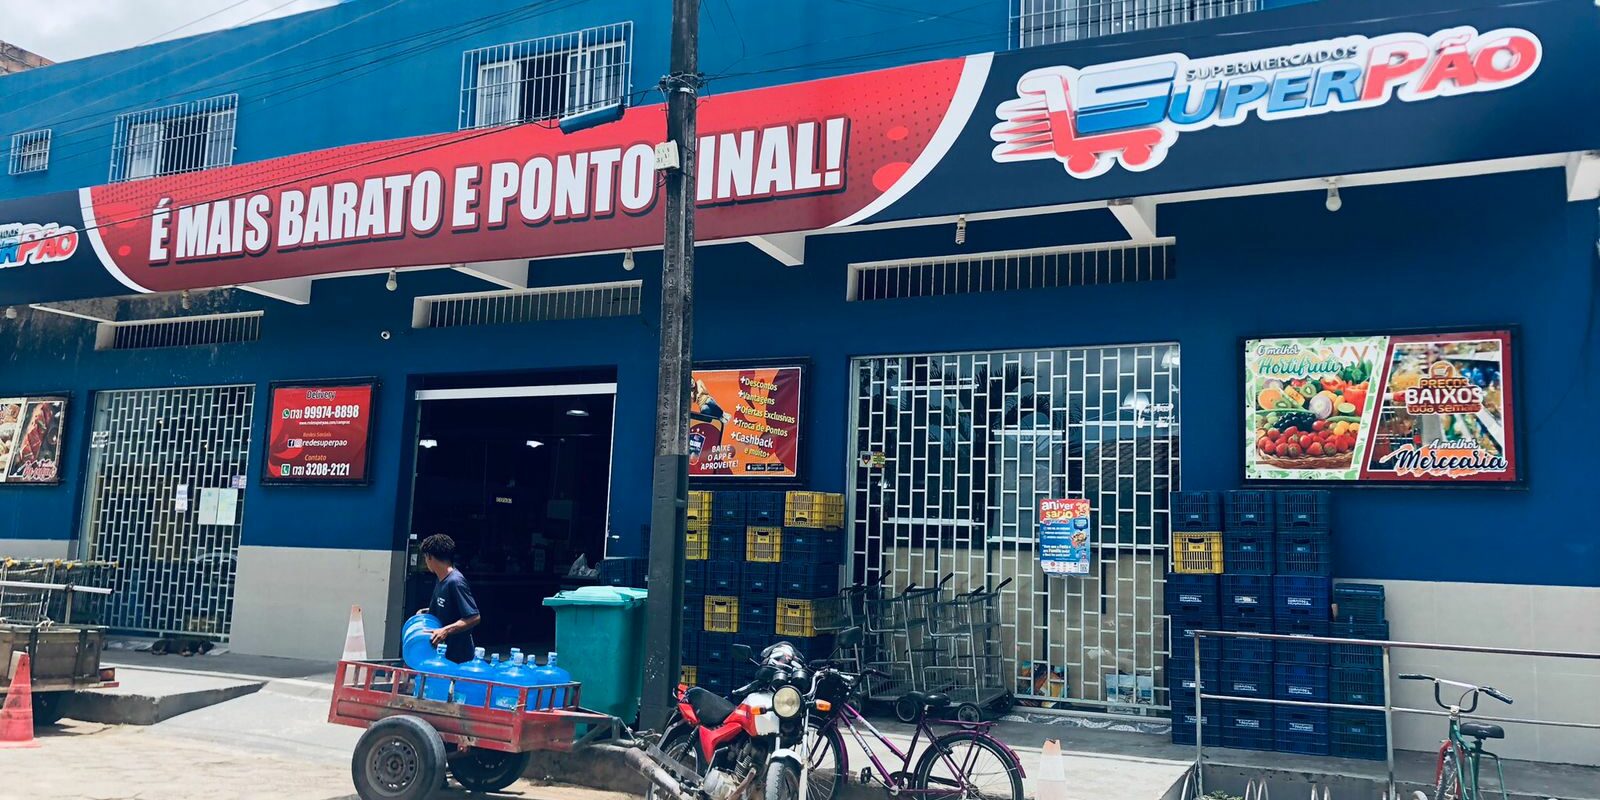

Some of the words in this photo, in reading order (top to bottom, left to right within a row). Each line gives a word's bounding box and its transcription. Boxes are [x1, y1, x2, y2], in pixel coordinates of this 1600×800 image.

[1185, 45, 1358, 84] SUPERMERCADOS
[149, 199, 172, 261] É
[176, 194, 271, 258] MAIS
[278, 170, 441, 247] BARATO
[453, 166, 478, 227] E
[488, 143, 655, 223] PONTO
[695, 117, 845, 201] INAL!
[1266, 344, 1300, 355] melhor
[1259, 356, 1340, 376] Hortifruti
[1420, 378, 1468, 389] PREÇOS
[306, 390, 336, 401] Delivery
[1405, 387, 1482, 405] BAIXOS
[304, 405, 359, 419] 99974-8898
[764, 410, 795, 424] Exclusivas
[756, 423, 765, 432] de
[765, 425, 788, 437] Pontos
[711, 445, 731, 453] BAIXE
[1440, 438, 1479, 449] melhor
[713, 453, 727, 461] APP
[727, 452, 732, 460] E
[1397, 449, 1507, 470] Mercearia
[292, 466, 304, 476] (73)
[306, 463, 350, 476] 3208-2121
[700, 460, 739, 471] APROVEITE!
[1041, 500, 1074, 510] aniver
[1045, 509, 1073, 518] sario
